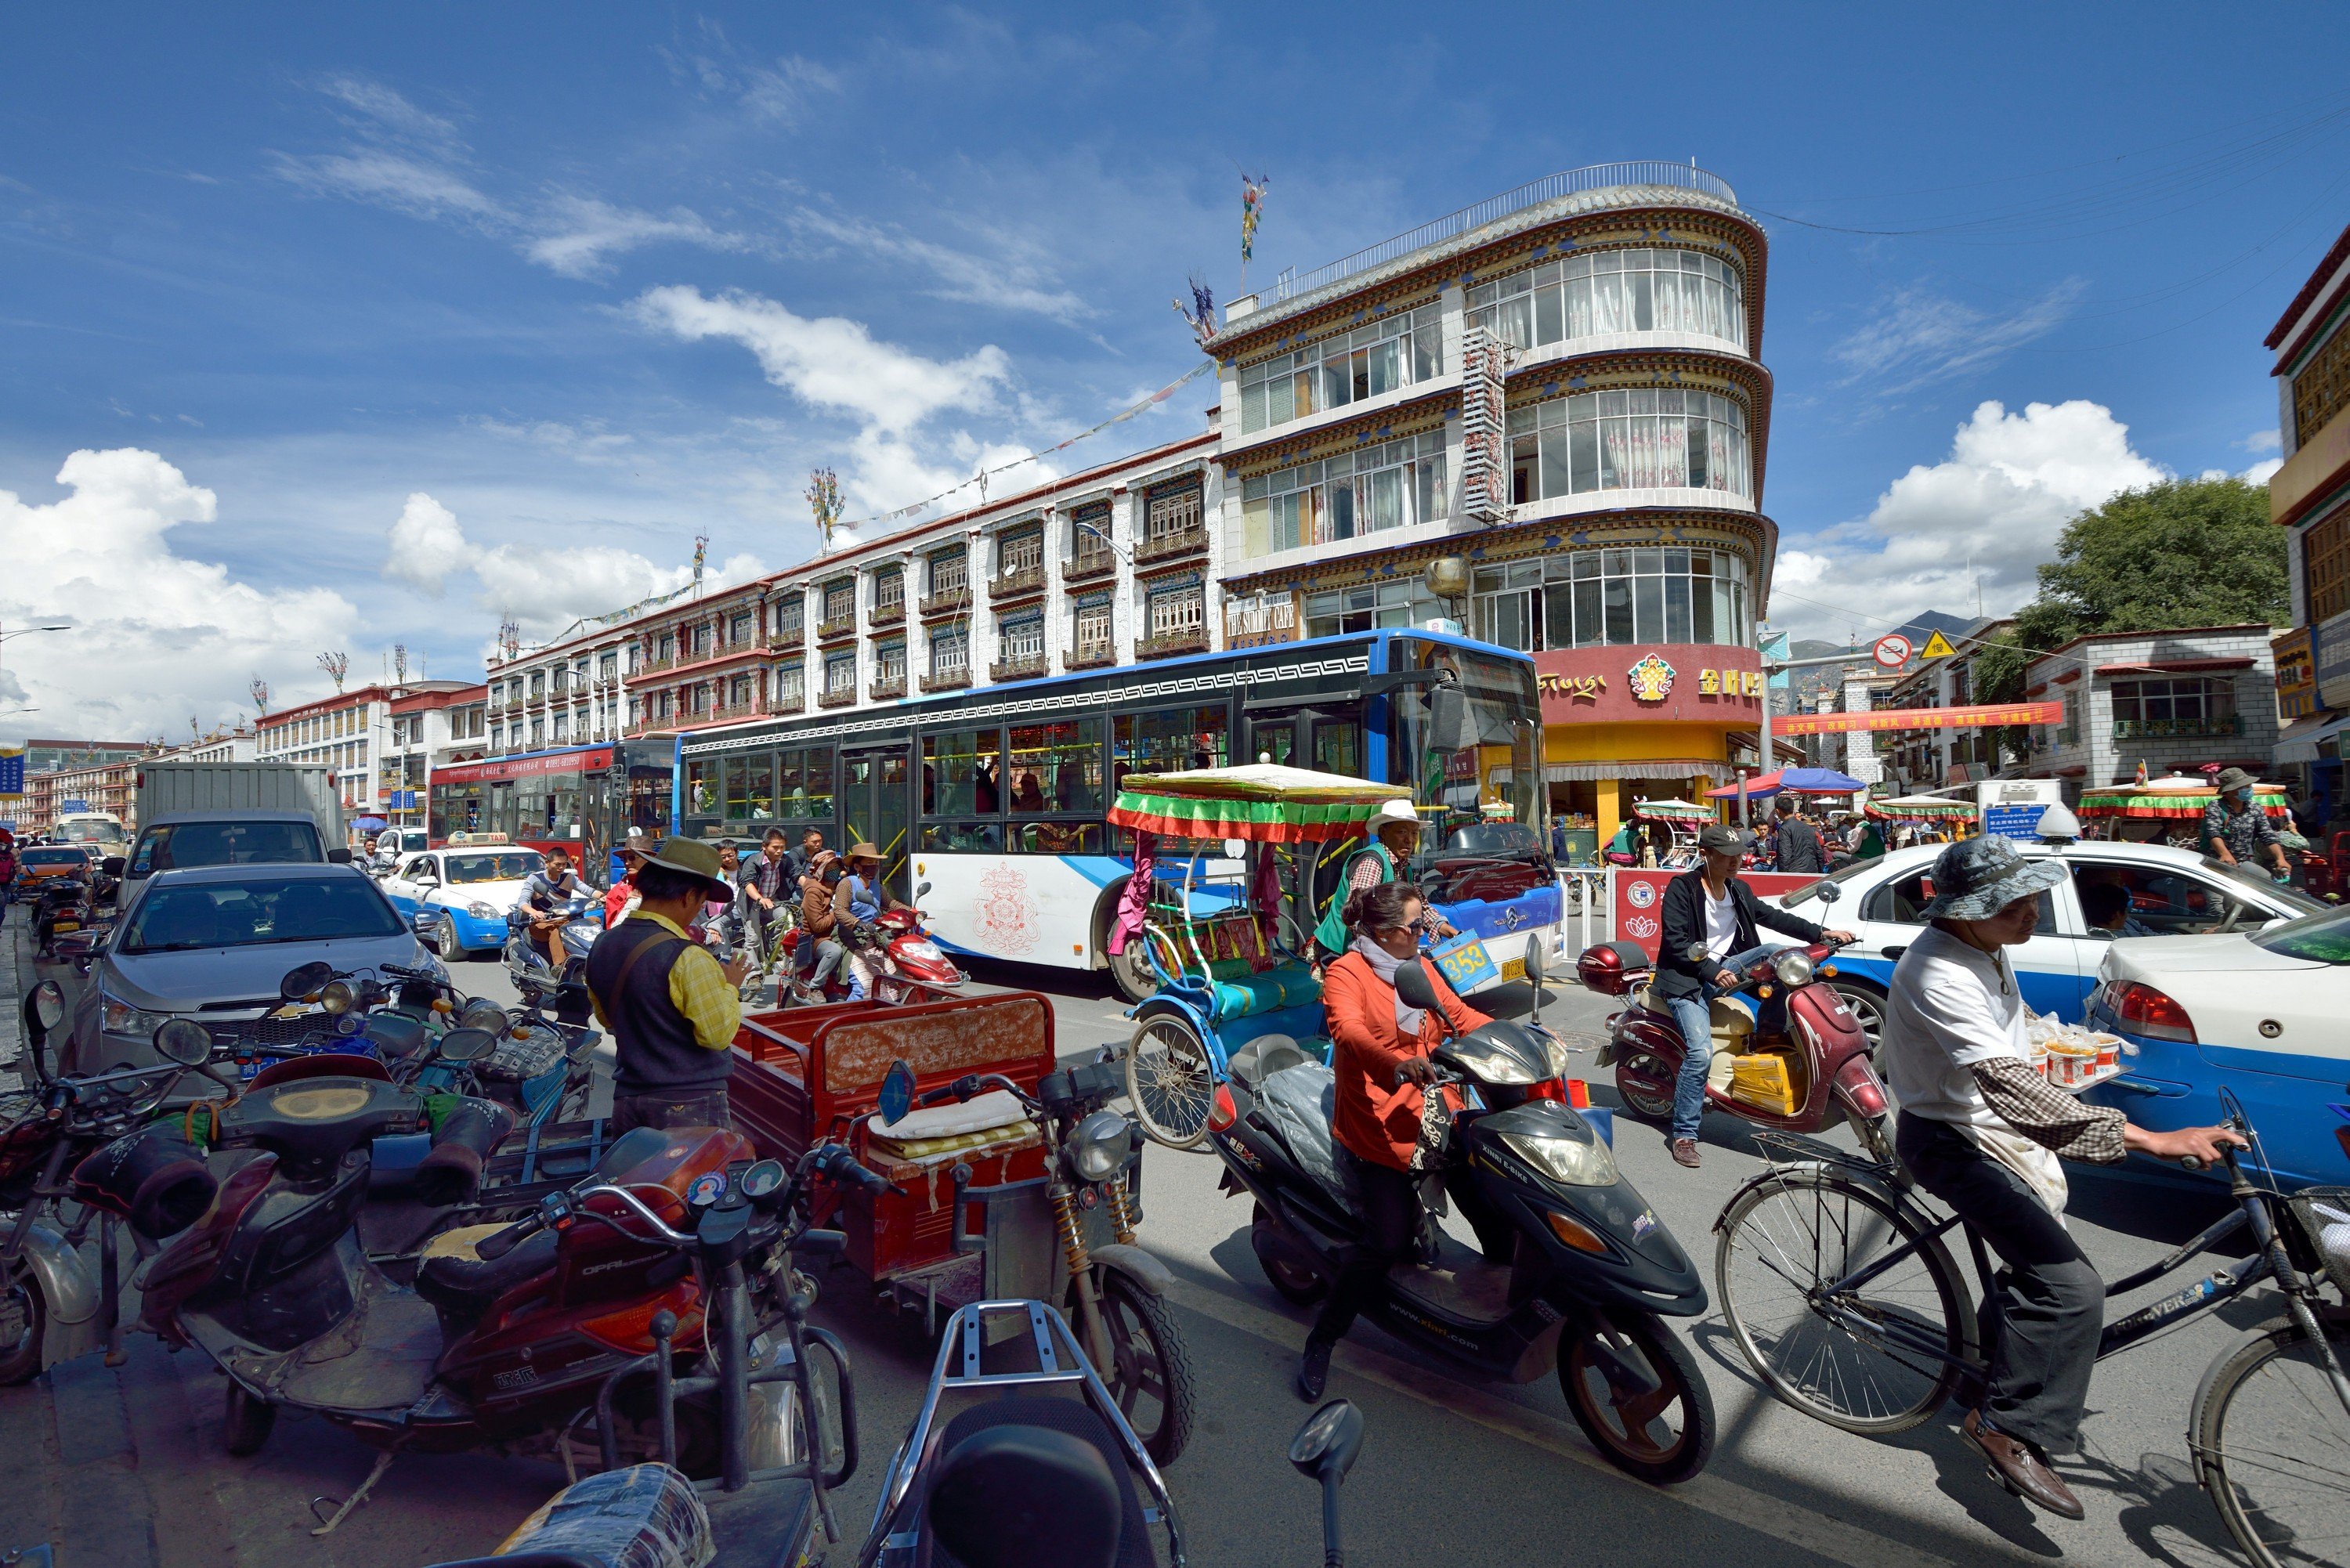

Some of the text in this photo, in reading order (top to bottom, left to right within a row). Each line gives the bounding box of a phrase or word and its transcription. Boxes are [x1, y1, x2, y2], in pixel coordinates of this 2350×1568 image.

[1227, 605, 1294, 637] THE SUMMIT CAFE
[1231, 633, 1289, 649] BISTRO
[1932, 642, 1944, 653] 慢
[1726, 830, 1740, 842] NY
[1444, 945, 1487, 982] 353
[1483, 1144, 1528, 1183] XINRI E-BIKE
[1389, 1302, 1480, 1351] www.xinri.com
[2112, 1295, 2186, 1335] FOREVER
